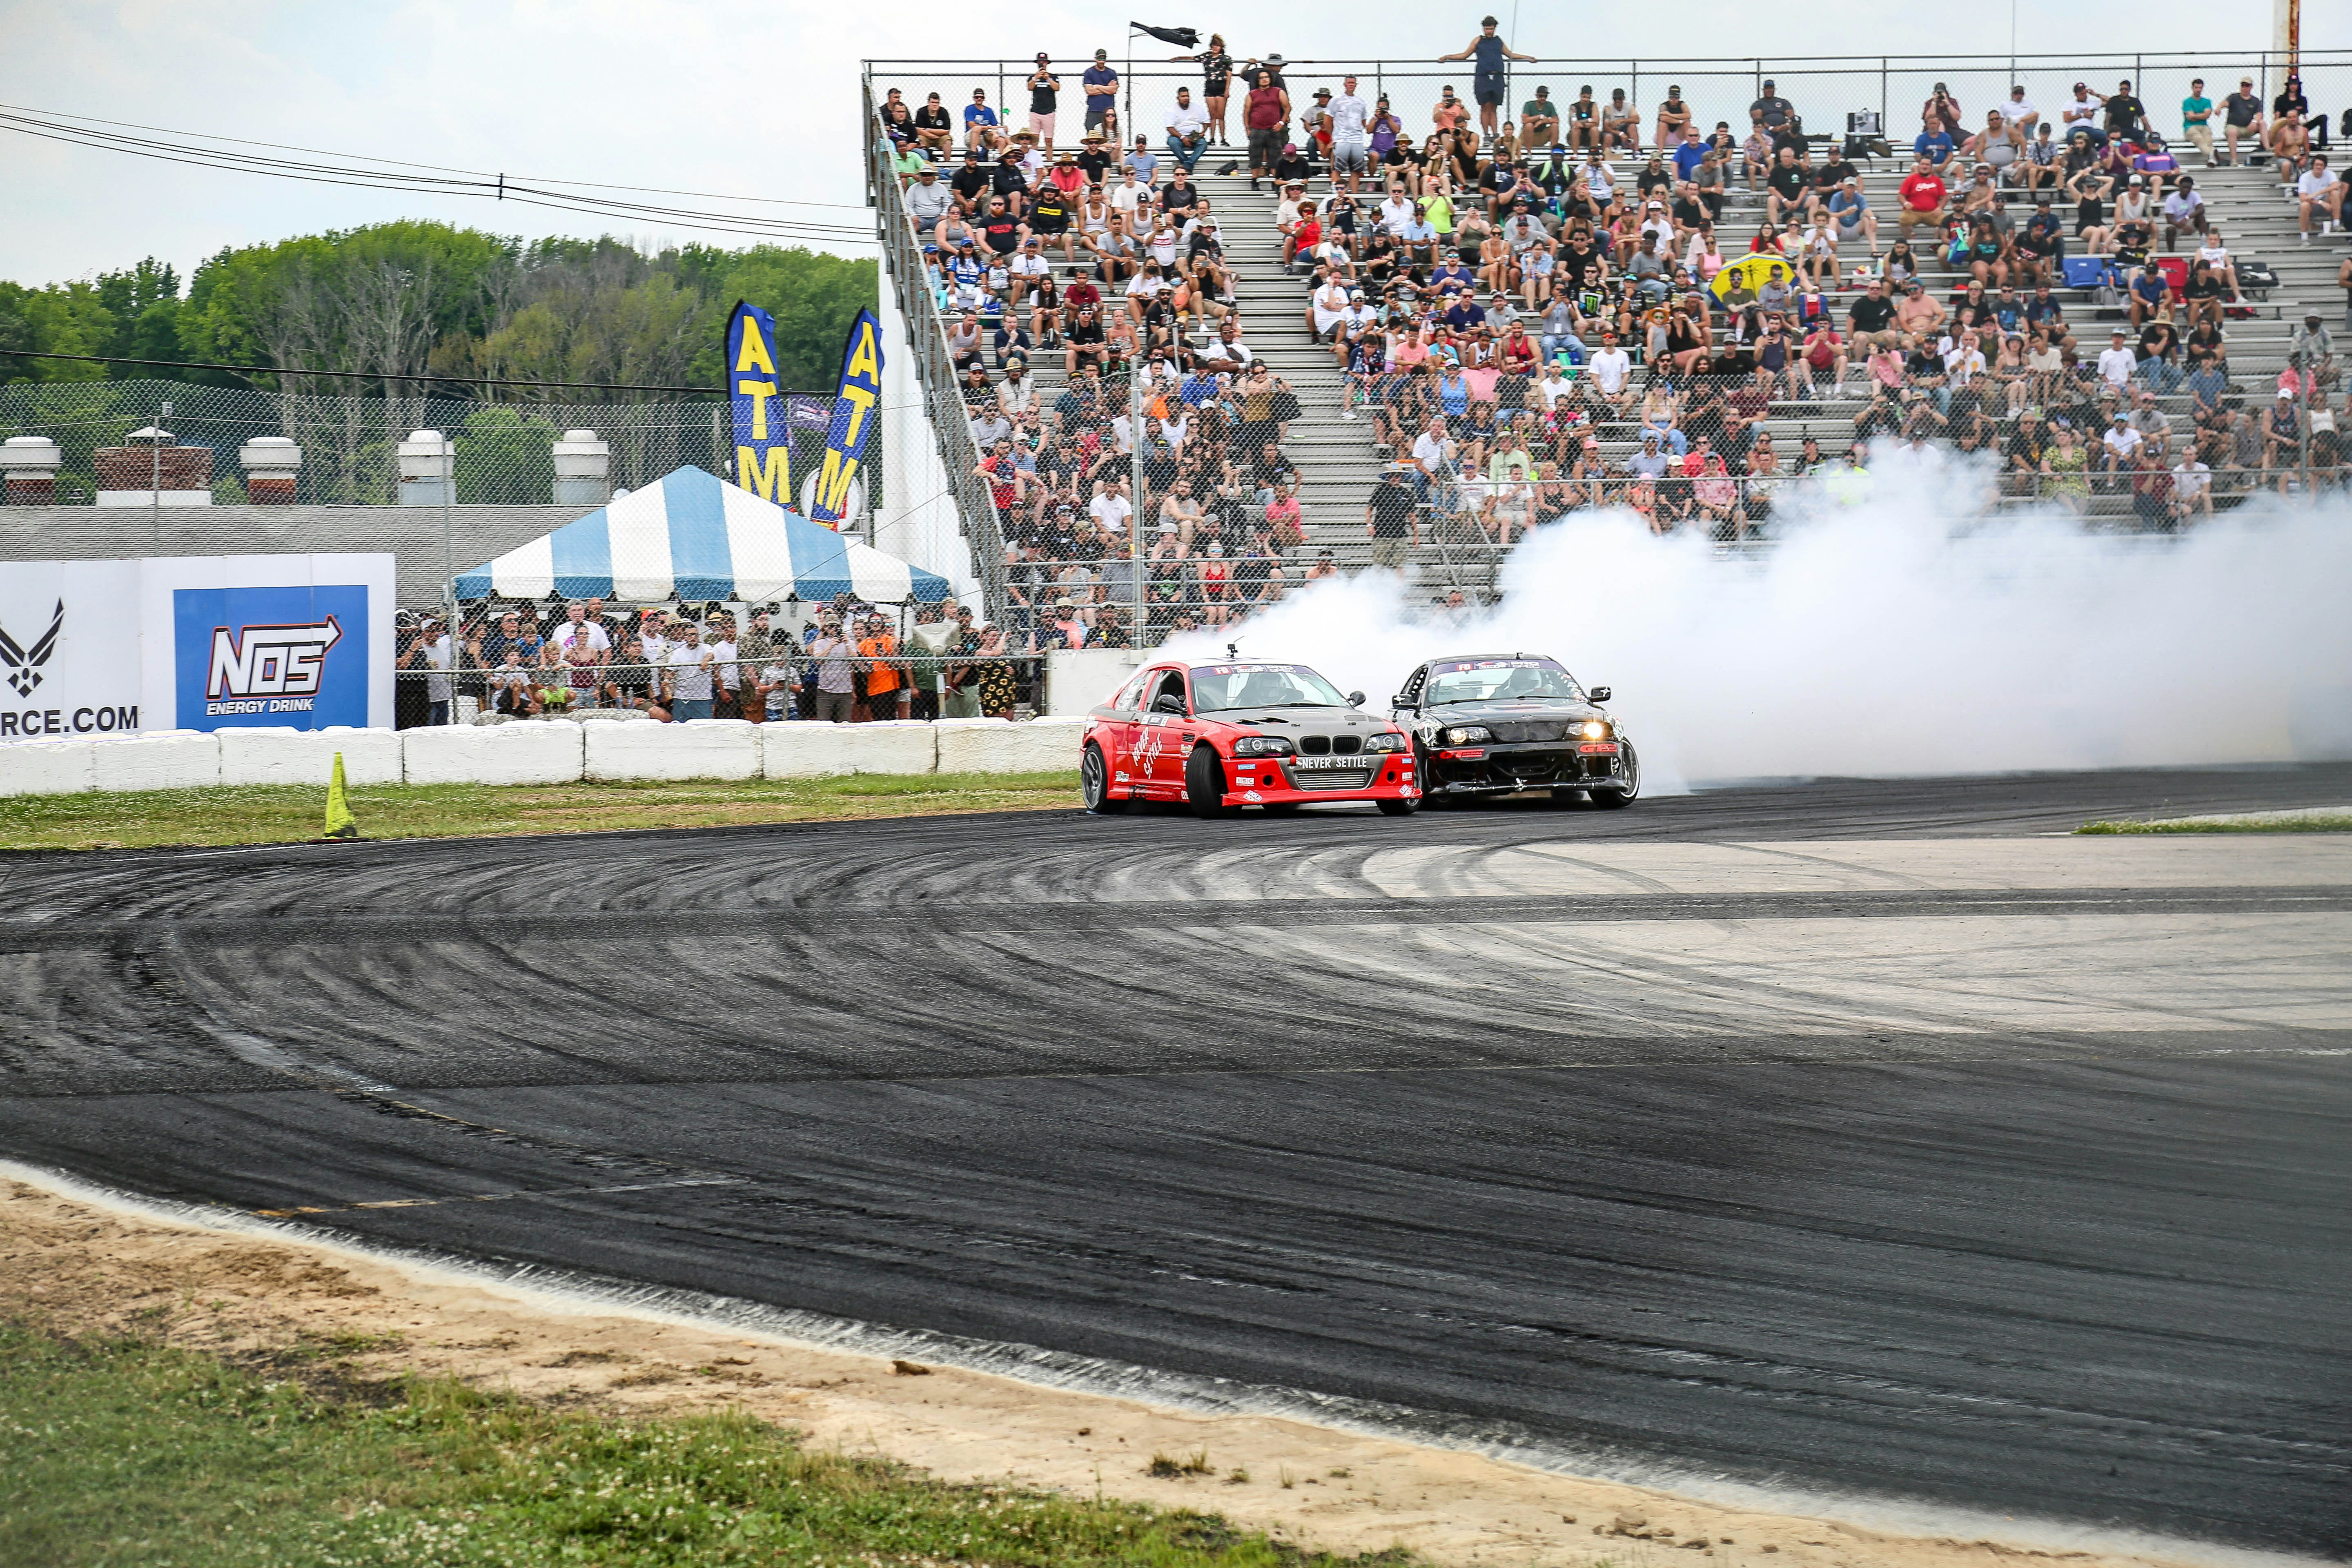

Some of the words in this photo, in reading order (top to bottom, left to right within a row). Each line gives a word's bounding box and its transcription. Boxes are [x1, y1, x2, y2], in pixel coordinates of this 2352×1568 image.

[735, 315, 791, 504] ATM
[816, 321, 879, 515] ATM
[206, 615, 343, 700] NOS
[1, 705, 138, 736] RCE.COM
[206, 699, 268, 716] ENERGY
[268, 697, 315, 713] DRINK
[1302, 757, 1331, 769] NEVER
[1336, 756, 1367, 768] SETTLE
